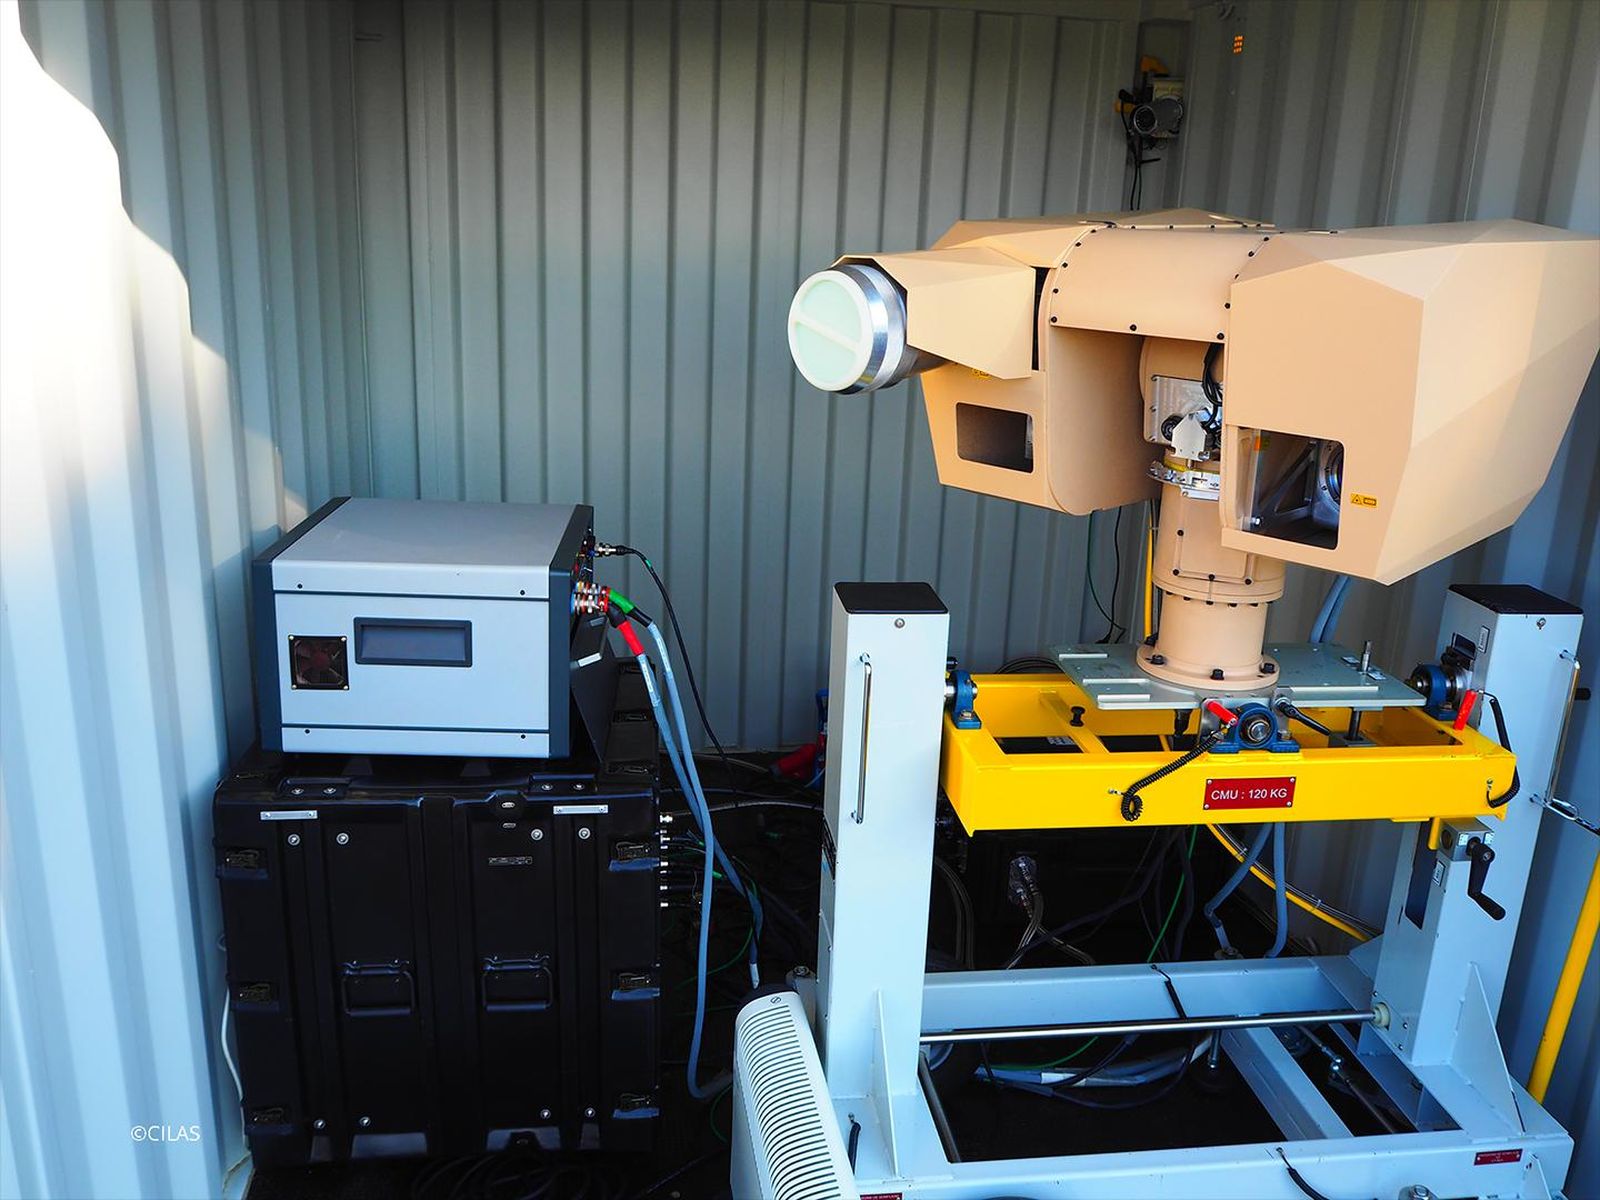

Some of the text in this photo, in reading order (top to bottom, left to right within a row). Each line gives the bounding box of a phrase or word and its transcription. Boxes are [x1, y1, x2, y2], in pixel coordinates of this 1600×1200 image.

[1211, 790, 1238, 800] CMU
[1249, 789, 1267, 799] 120
[1270, 788, 1287, 798] KG
